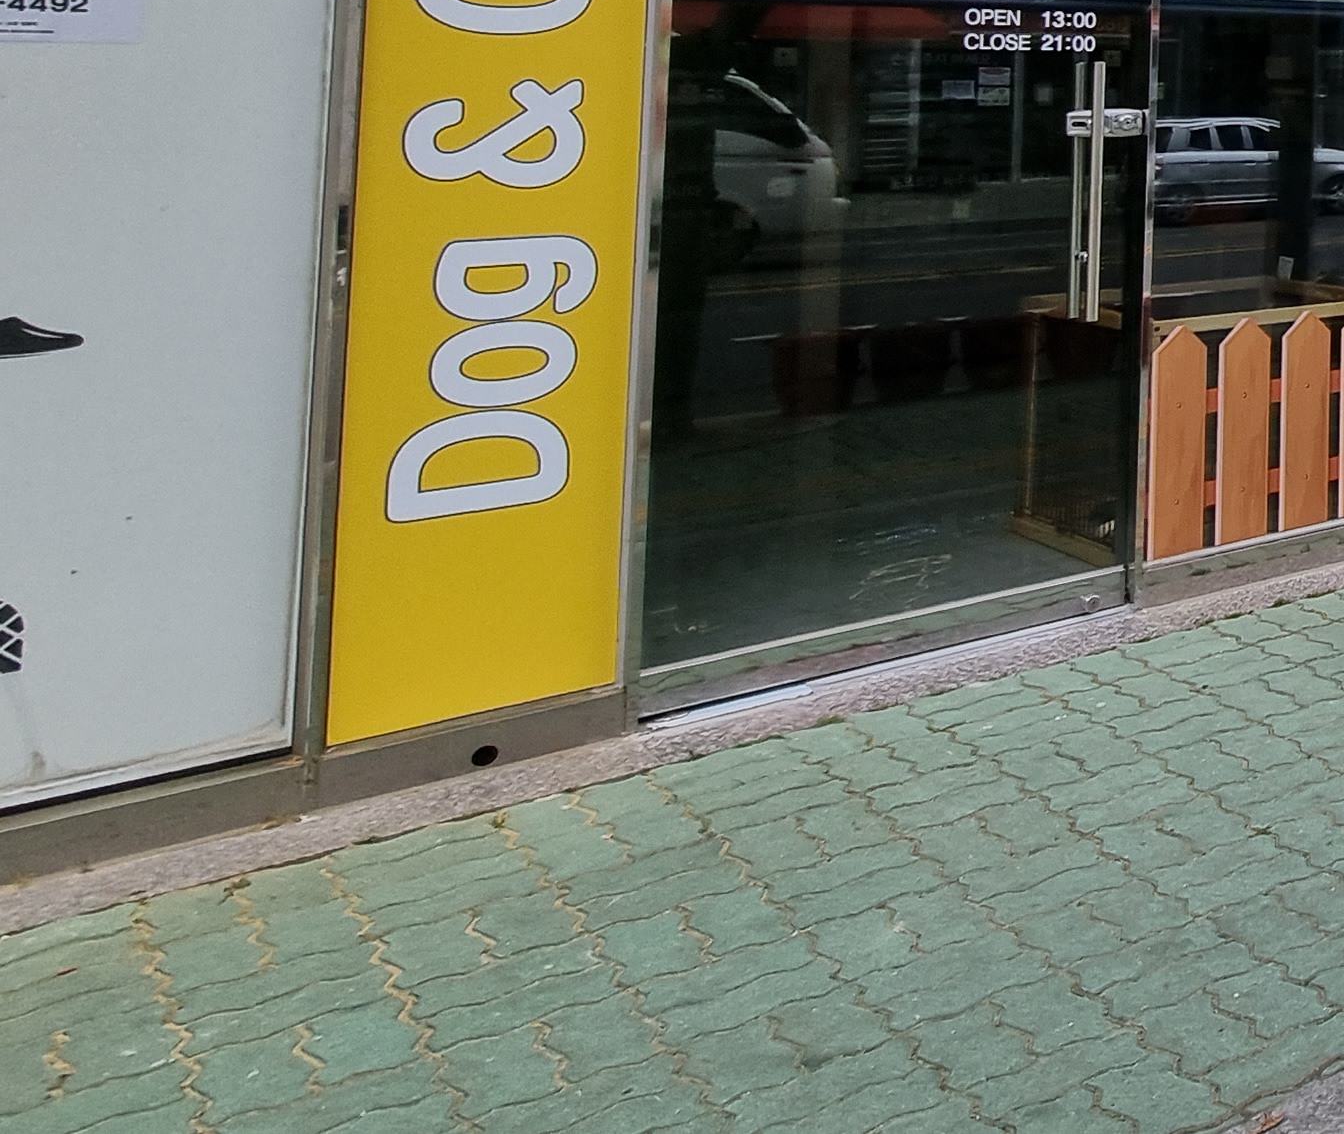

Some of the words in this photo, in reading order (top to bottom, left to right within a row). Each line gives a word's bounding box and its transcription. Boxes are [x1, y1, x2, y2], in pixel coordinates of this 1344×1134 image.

[963, 7, 1022, 27] OPEN
[1041, 9, 1097, 29] 13:00
[963, 32, 1031, 52] CLOSE
[1040, 33, 1096, 52] 21:00
[402, 78, 586, 189] &
[384, 233, 599, 524] Dog
